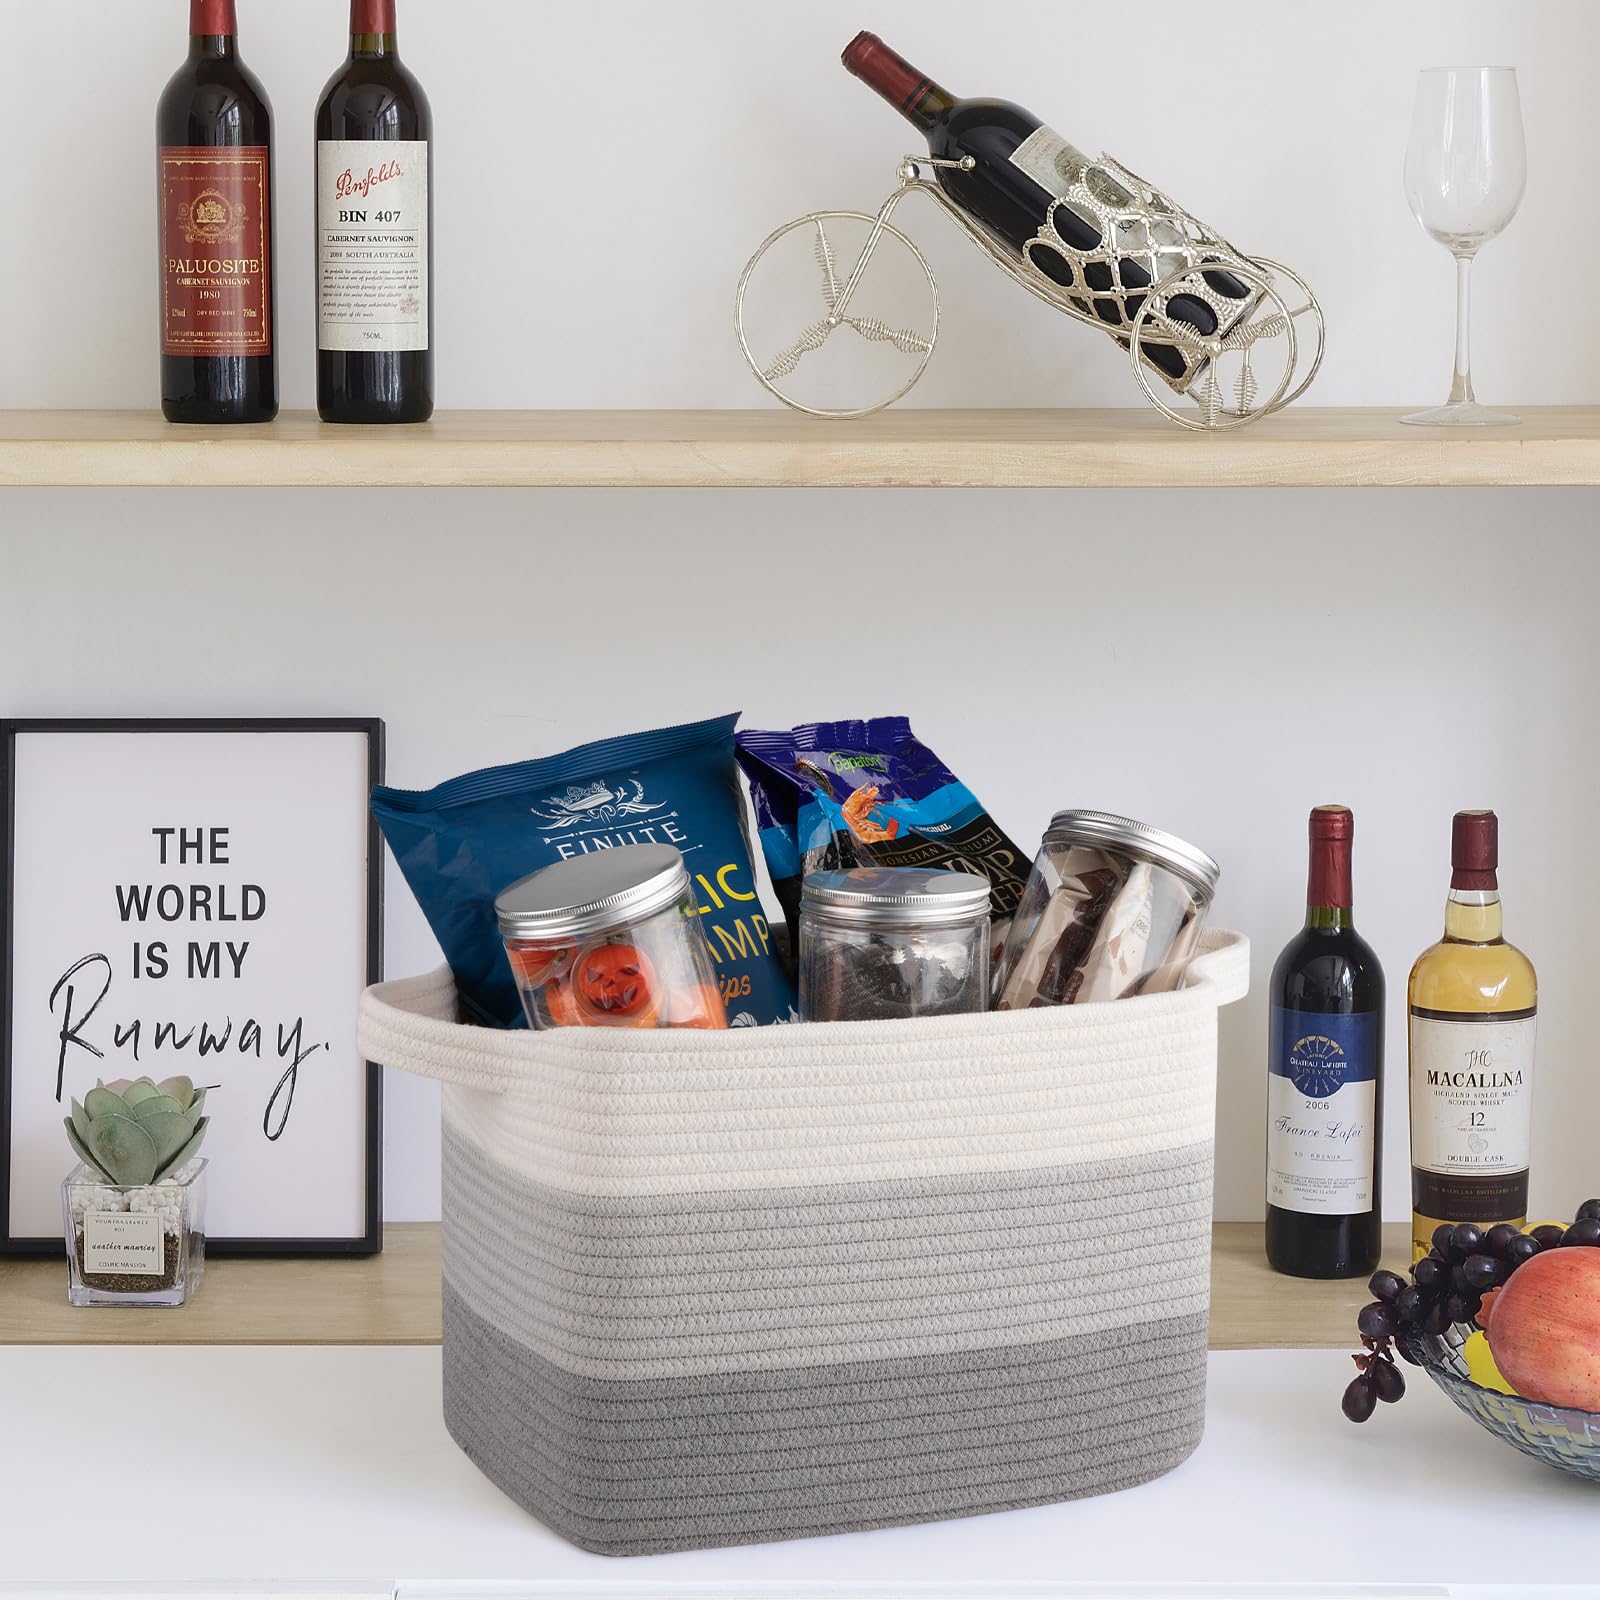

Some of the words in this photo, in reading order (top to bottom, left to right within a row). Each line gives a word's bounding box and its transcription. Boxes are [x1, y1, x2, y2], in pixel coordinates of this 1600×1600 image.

[339, 210, 367, 222] BIN
[375, 210, 401, 222] 407
[327, 235, 365, 243] CABERNET
[367, 235, 414, 243] SAUVIGNON
[345, 251, 372, 259] SOUTH
[373, 251, 415, 259] AUSTRALIA
[168, 258, 260, 274] PALUOSITE
[176, 277, 209, 286] CABERNET
[210, 277, 251, 286] SAUVIGNON
[199, 290, 221, 299] 1980
[152, 827, 230, 865] THE
[115, 884, 266, 922] WORLD
[132, 941, 169, 979] IS
[187, 941, 250, 979] MY
[1426, 1069, 1524, 1089] MACALLNA
[1305, 1100, 1330, 1111] 2006
[1448, 1099, 1476, 1107] SCOTCH
[1470, 1111, 1486, 1127] 12
[1274, 1115, 1321, 1138] France
[1447, 1154, 1481, 1163] DOUBLE
[1484, 1154, 1505, 1163] CASK
